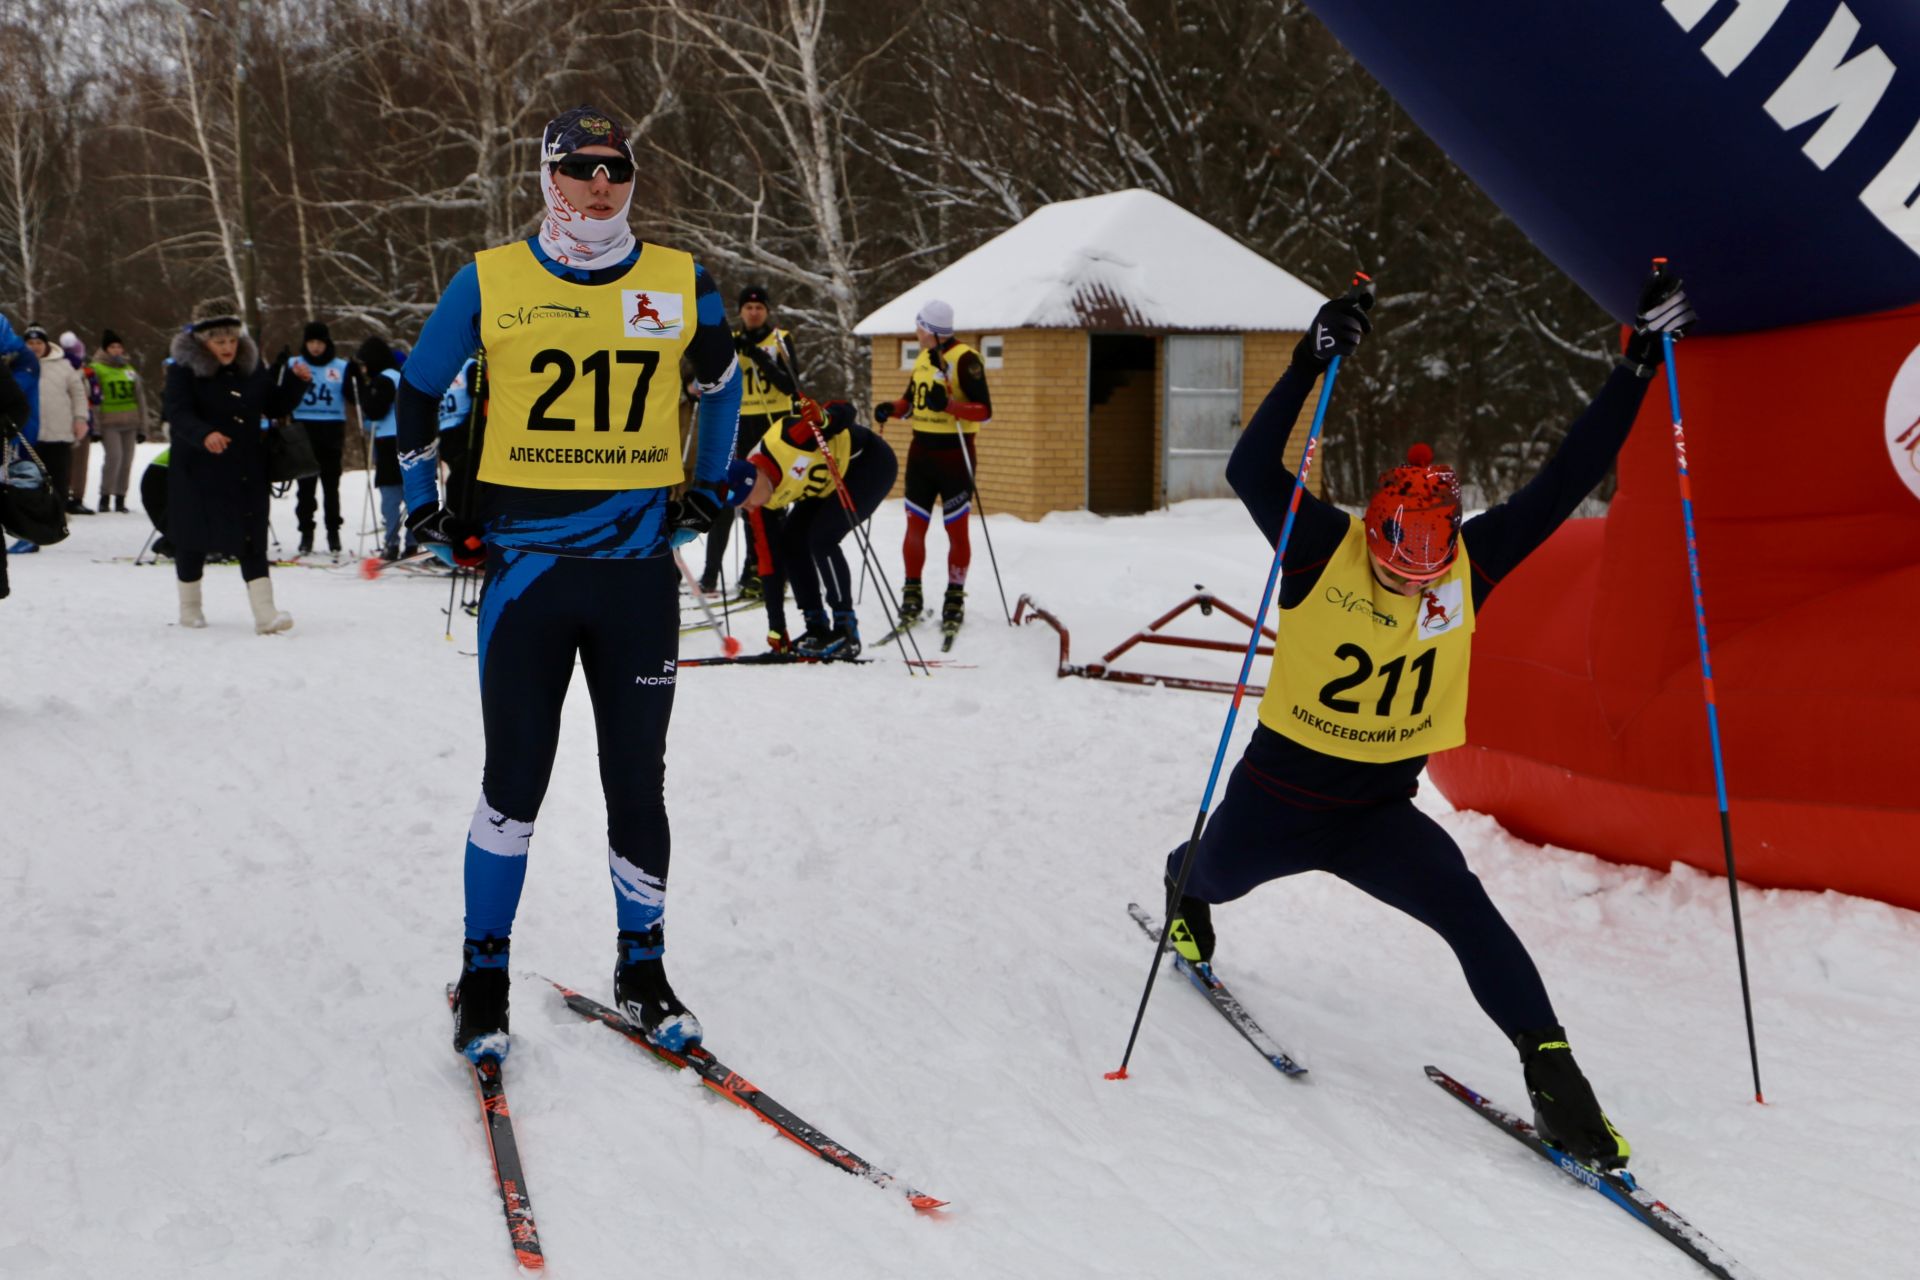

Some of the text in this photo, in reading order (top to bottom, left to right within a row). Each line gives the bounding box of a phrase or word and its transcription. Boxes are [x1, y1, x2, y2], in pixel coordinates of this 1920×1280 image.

[527, 348, 660, 432] 217
[509, 446, 669, 464] АЛЕКСЕЕВСКИЙ РАЙОН
[1318, 642, 1437, 717] 211
[1292, 704, 1396, 743] АЛЕКСЕЕВСКИЙ
